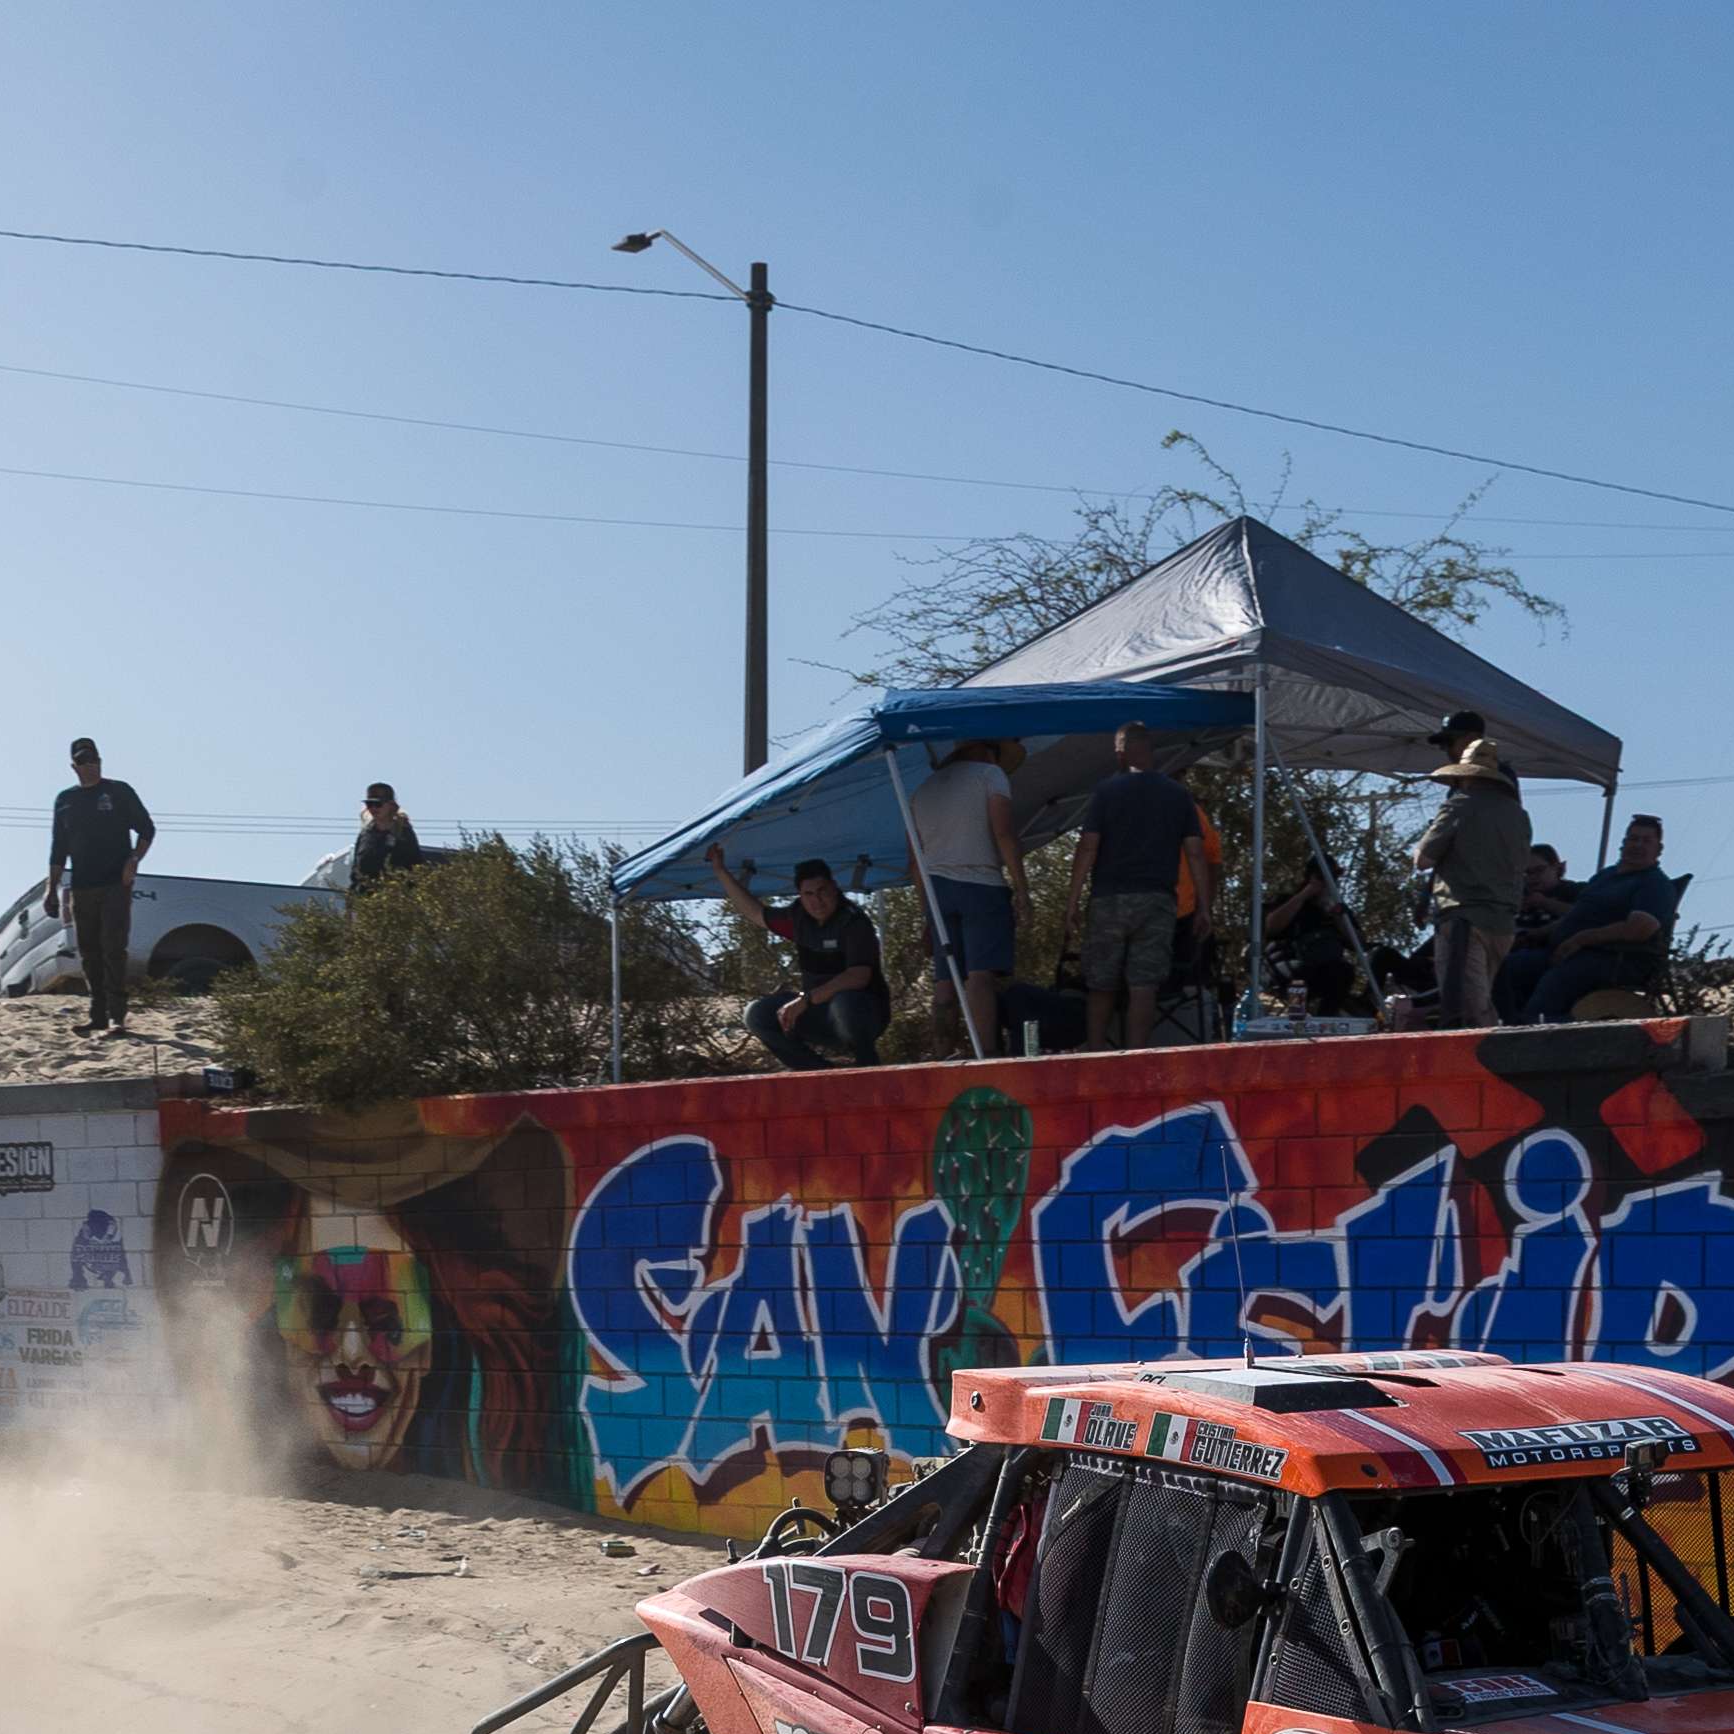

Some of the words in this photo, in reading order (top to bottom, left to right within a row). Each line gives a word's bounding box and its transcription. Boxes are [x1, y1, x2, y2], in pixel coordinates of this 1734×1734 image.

[8, 1301, 72, 1320] ELIZALDE
[569, 1134, 963, 1504] SAN
[27, 1327, 73, 1347] FRIDA
[18, 1347, 83, 1366] VARGAS
[1084, 1418, 1136, 1450] OLAVE
[1196, 1420, 1236, 1440] CRISTIAN
[1468, 1416, 1686, 1453] MAFUZAR
[1190, 1435, 1287, 1481] GUTIERREZ
[1489, 1437, 1697, 1468] MOTORSPTS
[762, 1556, 917, 1684] 179
